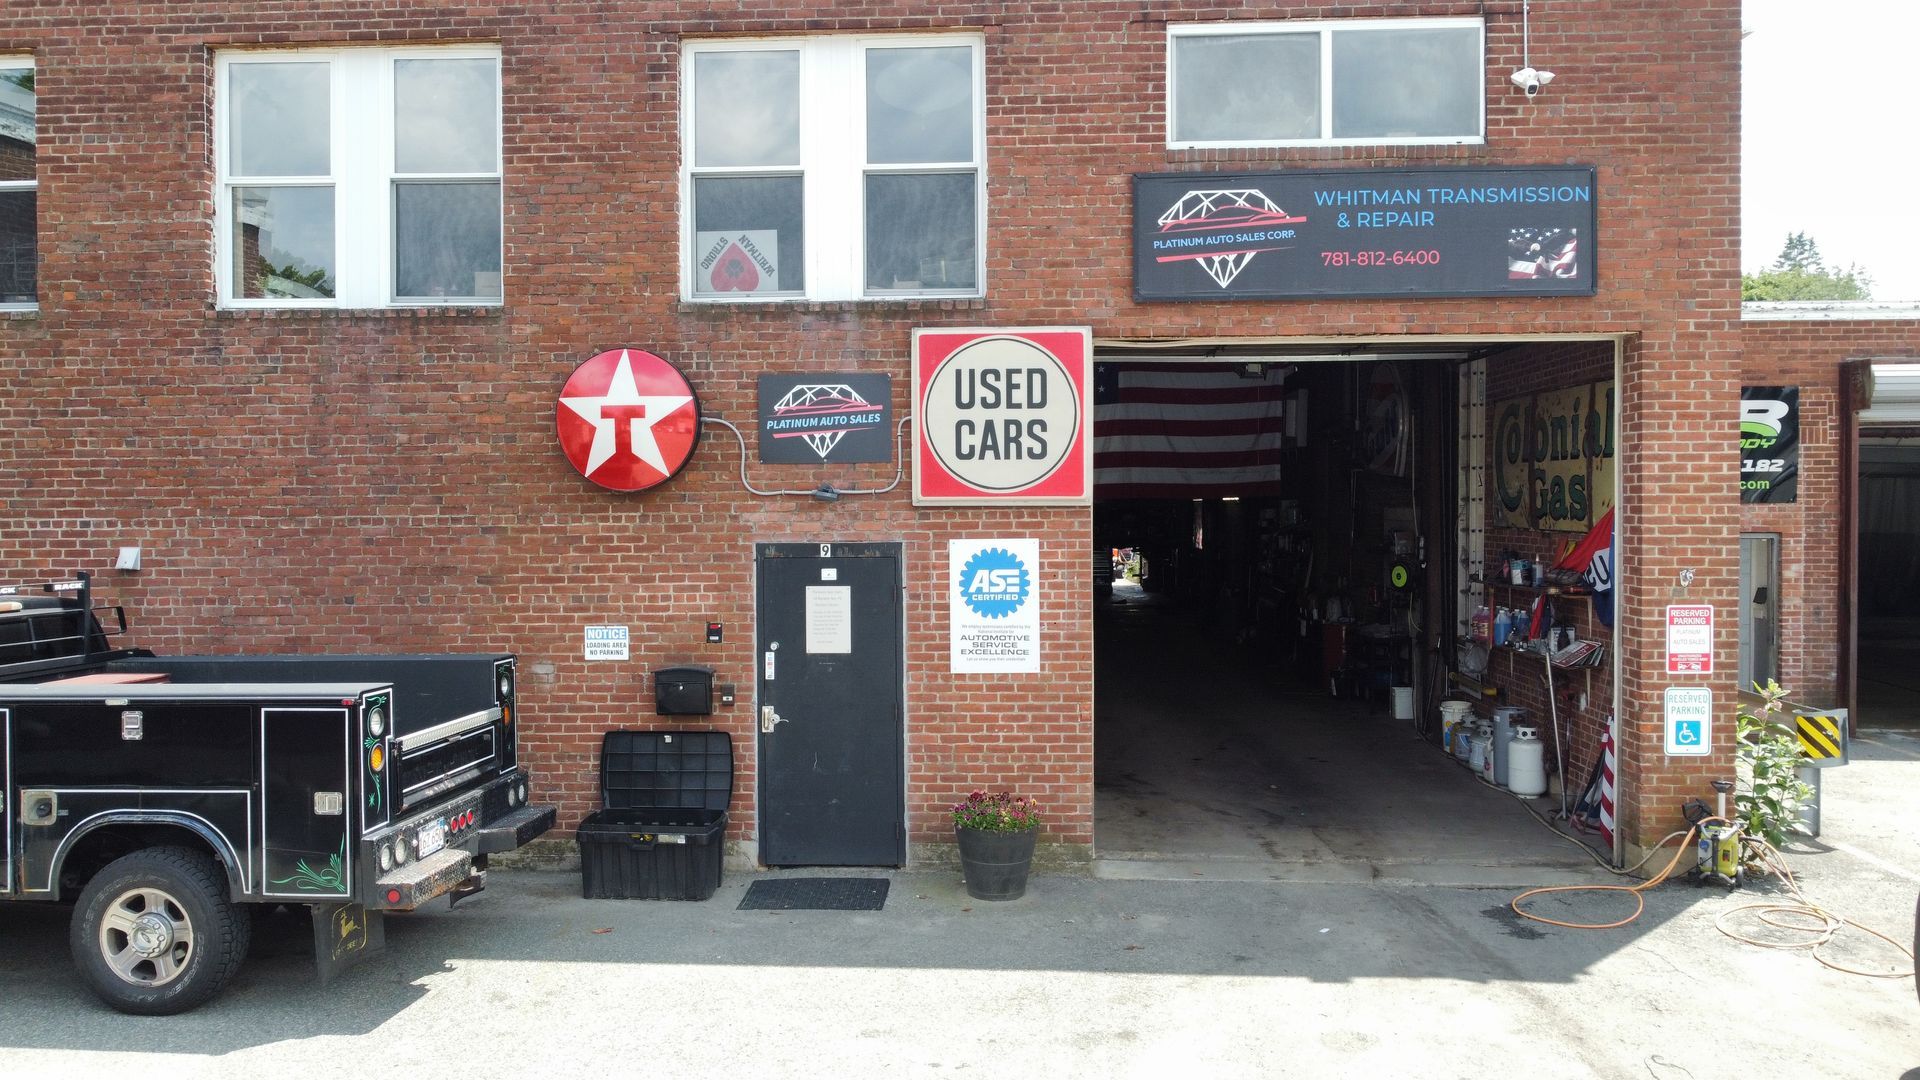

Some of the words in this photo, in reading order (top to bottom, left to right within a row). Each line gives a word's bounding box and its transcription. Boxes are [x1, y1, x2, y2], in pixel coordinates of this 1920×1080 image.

[1314, 189, 1421, 206] WHITMAN
[1426, 186, 1589, 204] TRANSMISSION
[1337, 213, 1350, 228] &
[1357, 211, 1435, 227] REPAIR
[1153, 238, 1204, 249] PLATINUM
[1205, 235, 1234, 245] AUTO
[1235, 232, 1266, 242] SALES
[1267, 230, 1296, 240] CORP.
[701, 236, 728, 270] STRONG
[738, 234, 775, 277] WHITMAN
[1321, 250, 1440, 267] 781-812-6400
[955, 368, 1047, 409] USED
[601, 405, 645, 453] T
[766, 418, 818, 430] PLATINUM
[819, 416, 847, 426] AUTO
[849, 413, 880, 424] SALES
[955, 419, 1047, 460] CARS
[1534, 468, 1588, 521] Gas
[822, 545, 829, 556] 9
[968, 569, 1020, 593] ASE
[1674, 617, 1706, 625] PARKING
[587, 628, 626, 639] NOTICE
[1668, 695, 1708, 704] RESERVED
[1671, 706, 1706, 715] PARKING
